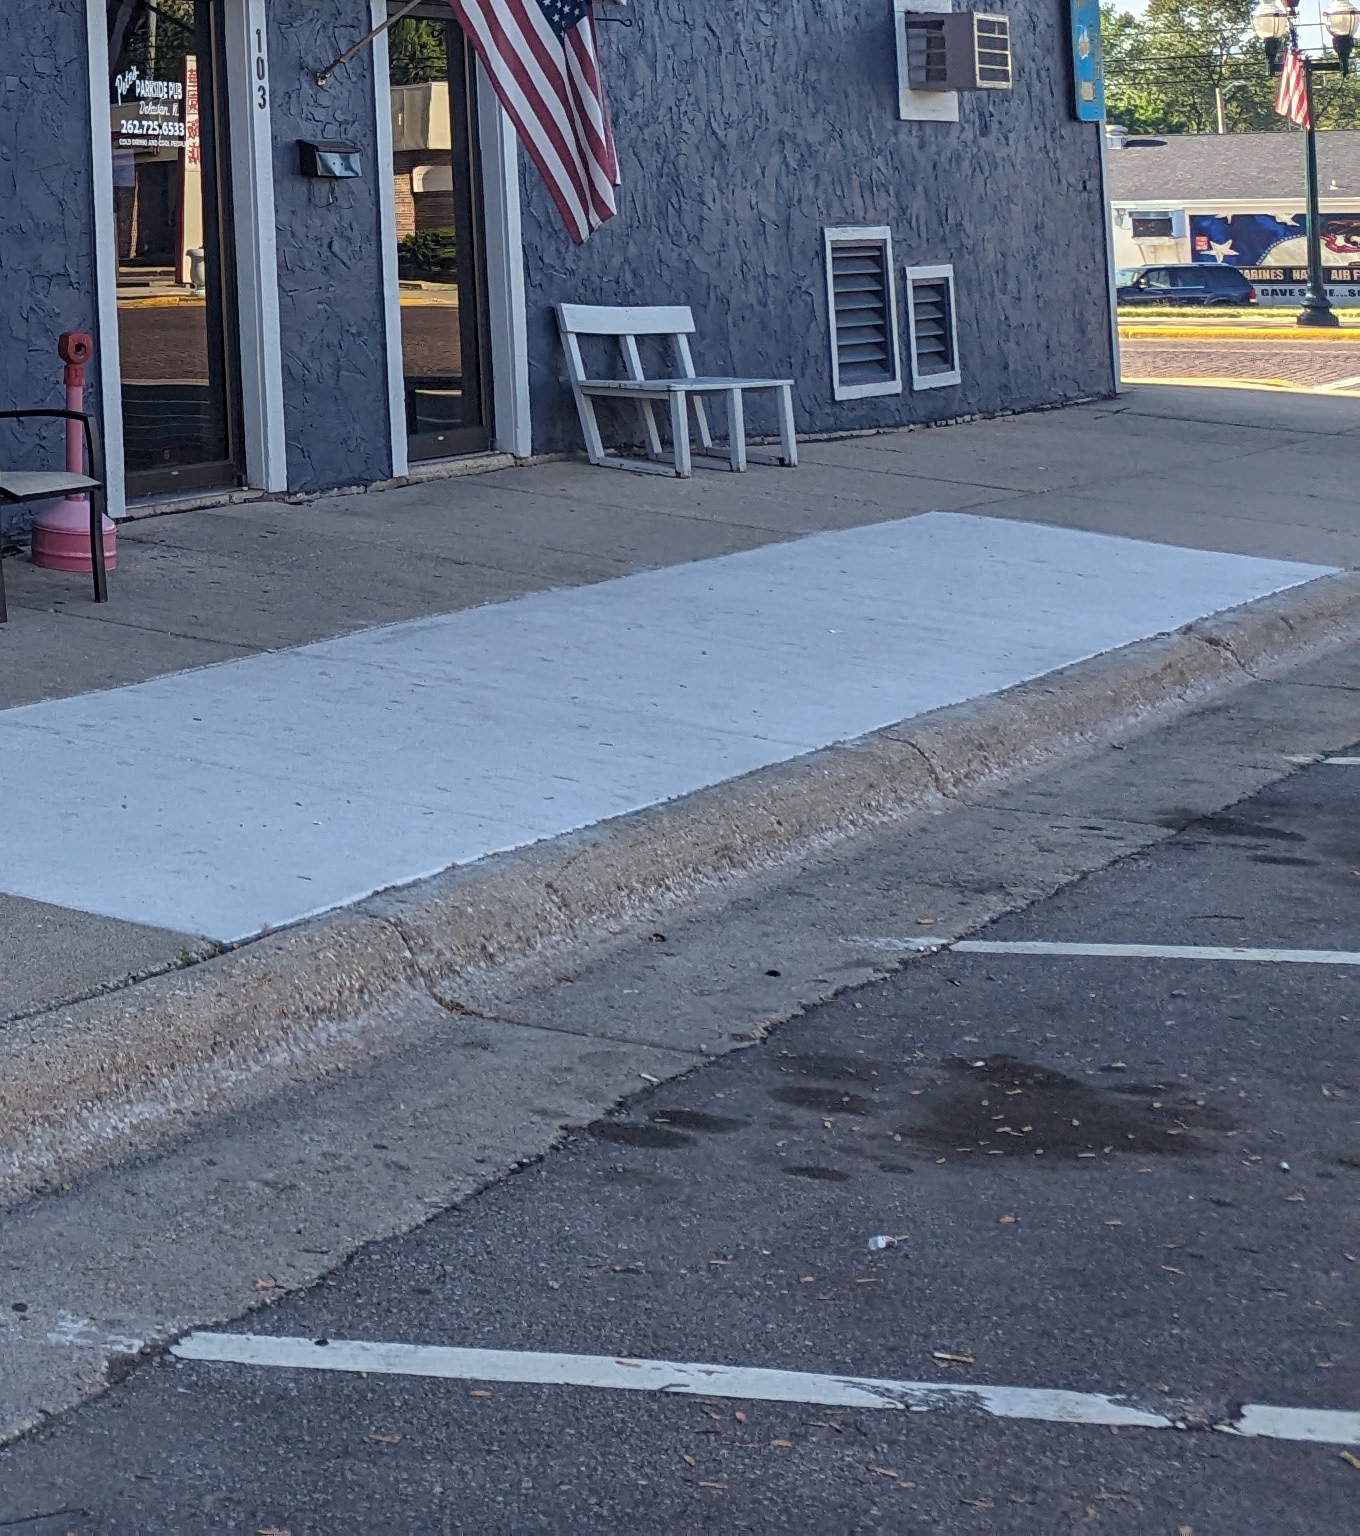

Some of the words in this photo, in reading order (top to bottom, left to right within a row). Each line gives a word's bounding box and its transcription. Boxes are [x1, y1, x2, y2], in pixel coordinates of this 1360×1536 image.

[255, 28, 267, 110] 103
[135, 80, 168, 99] PARKSIDE
[168, 81, 183, 100] PUB
[120, 120, 185, 136] 262.725.6533
[1331, 269, 1352, 280] AIR
[1261, 288, 1295, 297] GAVE
